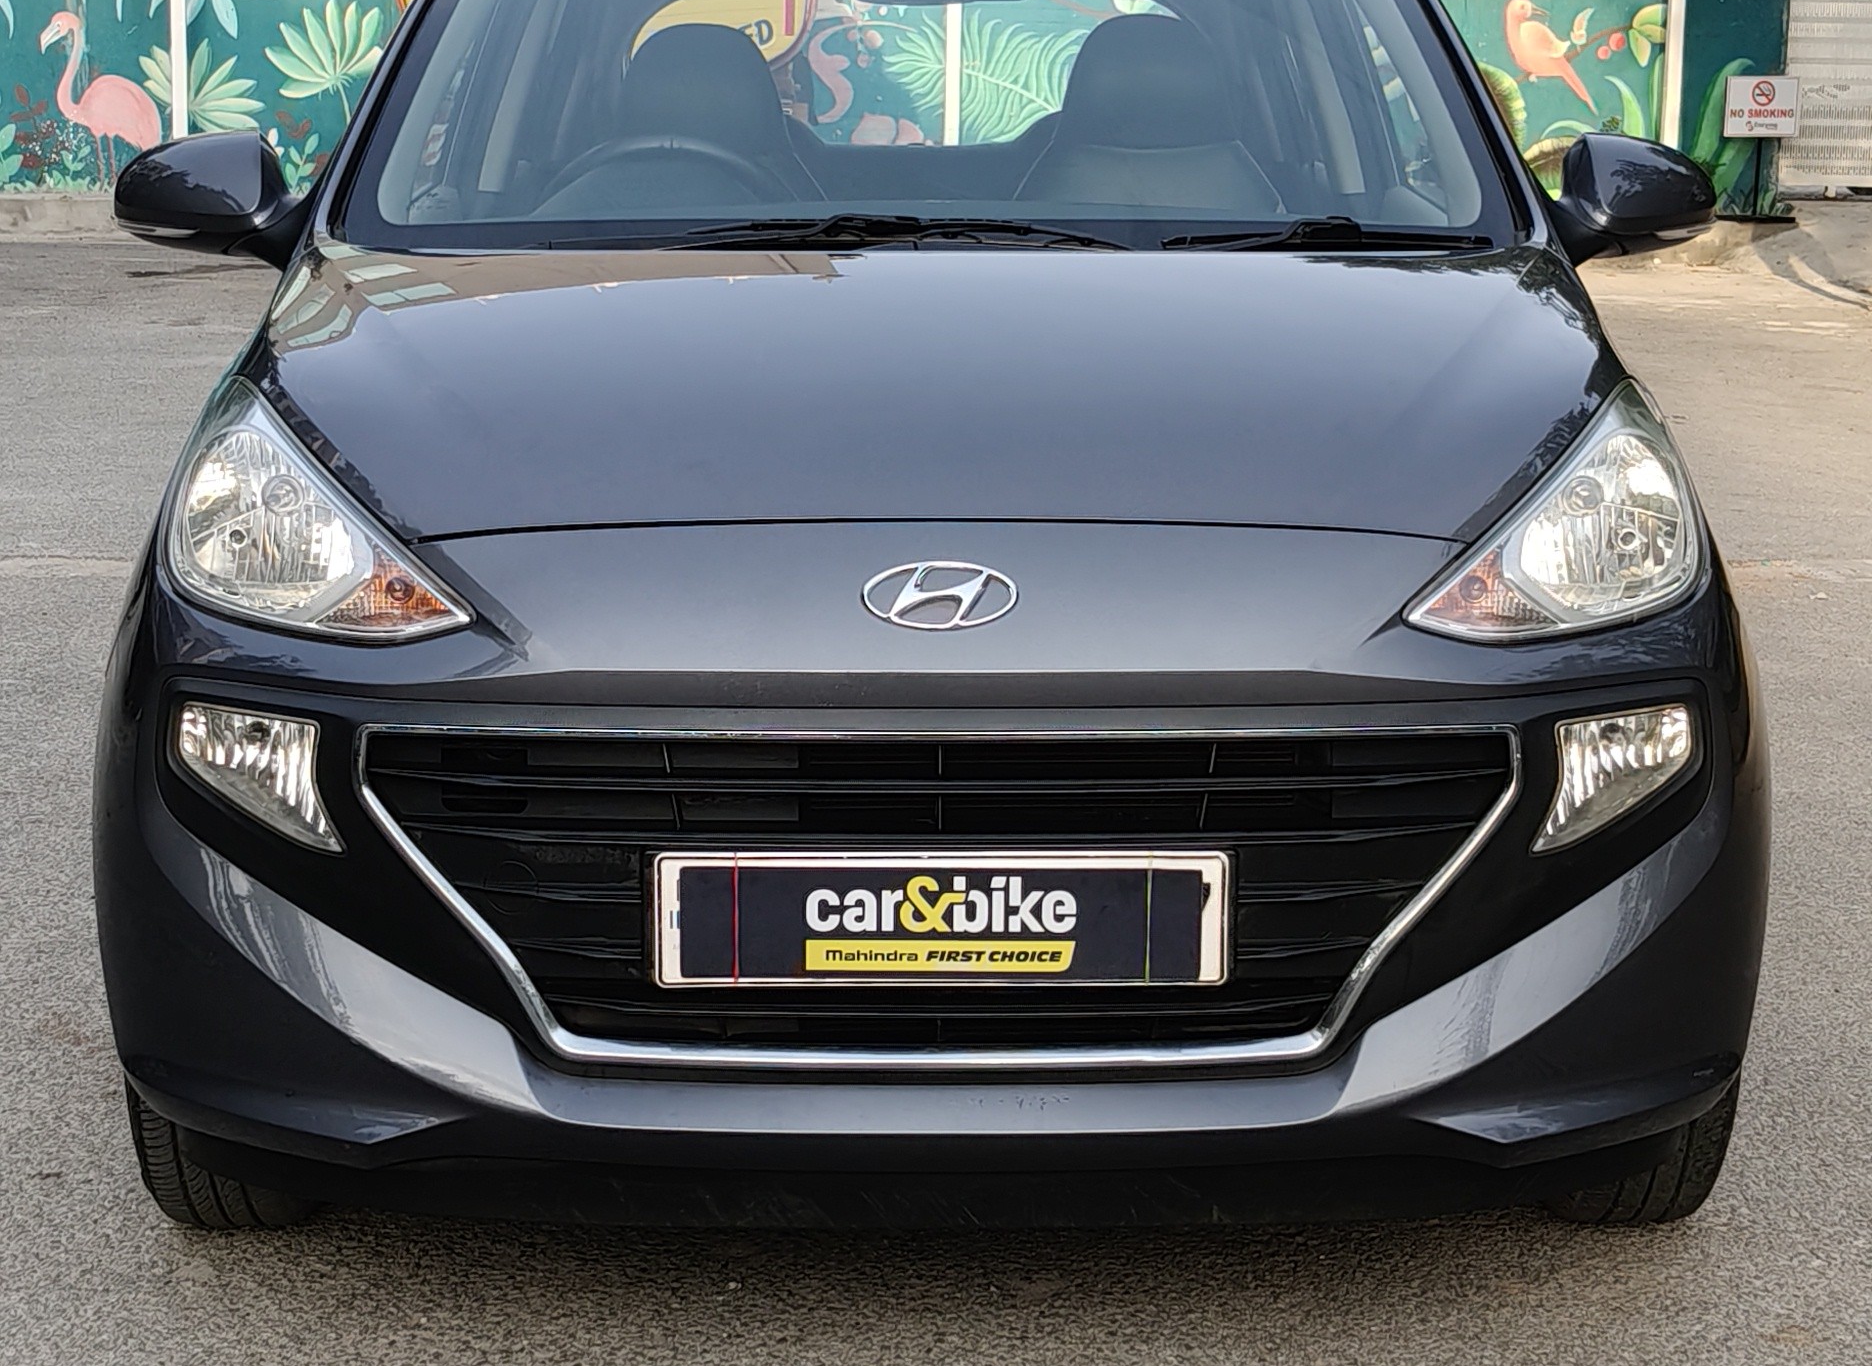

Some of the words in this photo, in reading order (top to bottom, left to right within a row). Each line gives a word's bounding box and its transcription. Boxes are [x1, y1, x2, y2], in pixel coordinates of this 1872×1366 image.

[1730, 108, 1745, 119] NO
[1747, 108, 1795, 119] SMOKING
[805, 875, 1077, 934] car&bike
[825, 949, 919, 962] Mahindra
[925, 950, 986, 963] FIRST
[988, 950, 1063, 963] CHOICE
